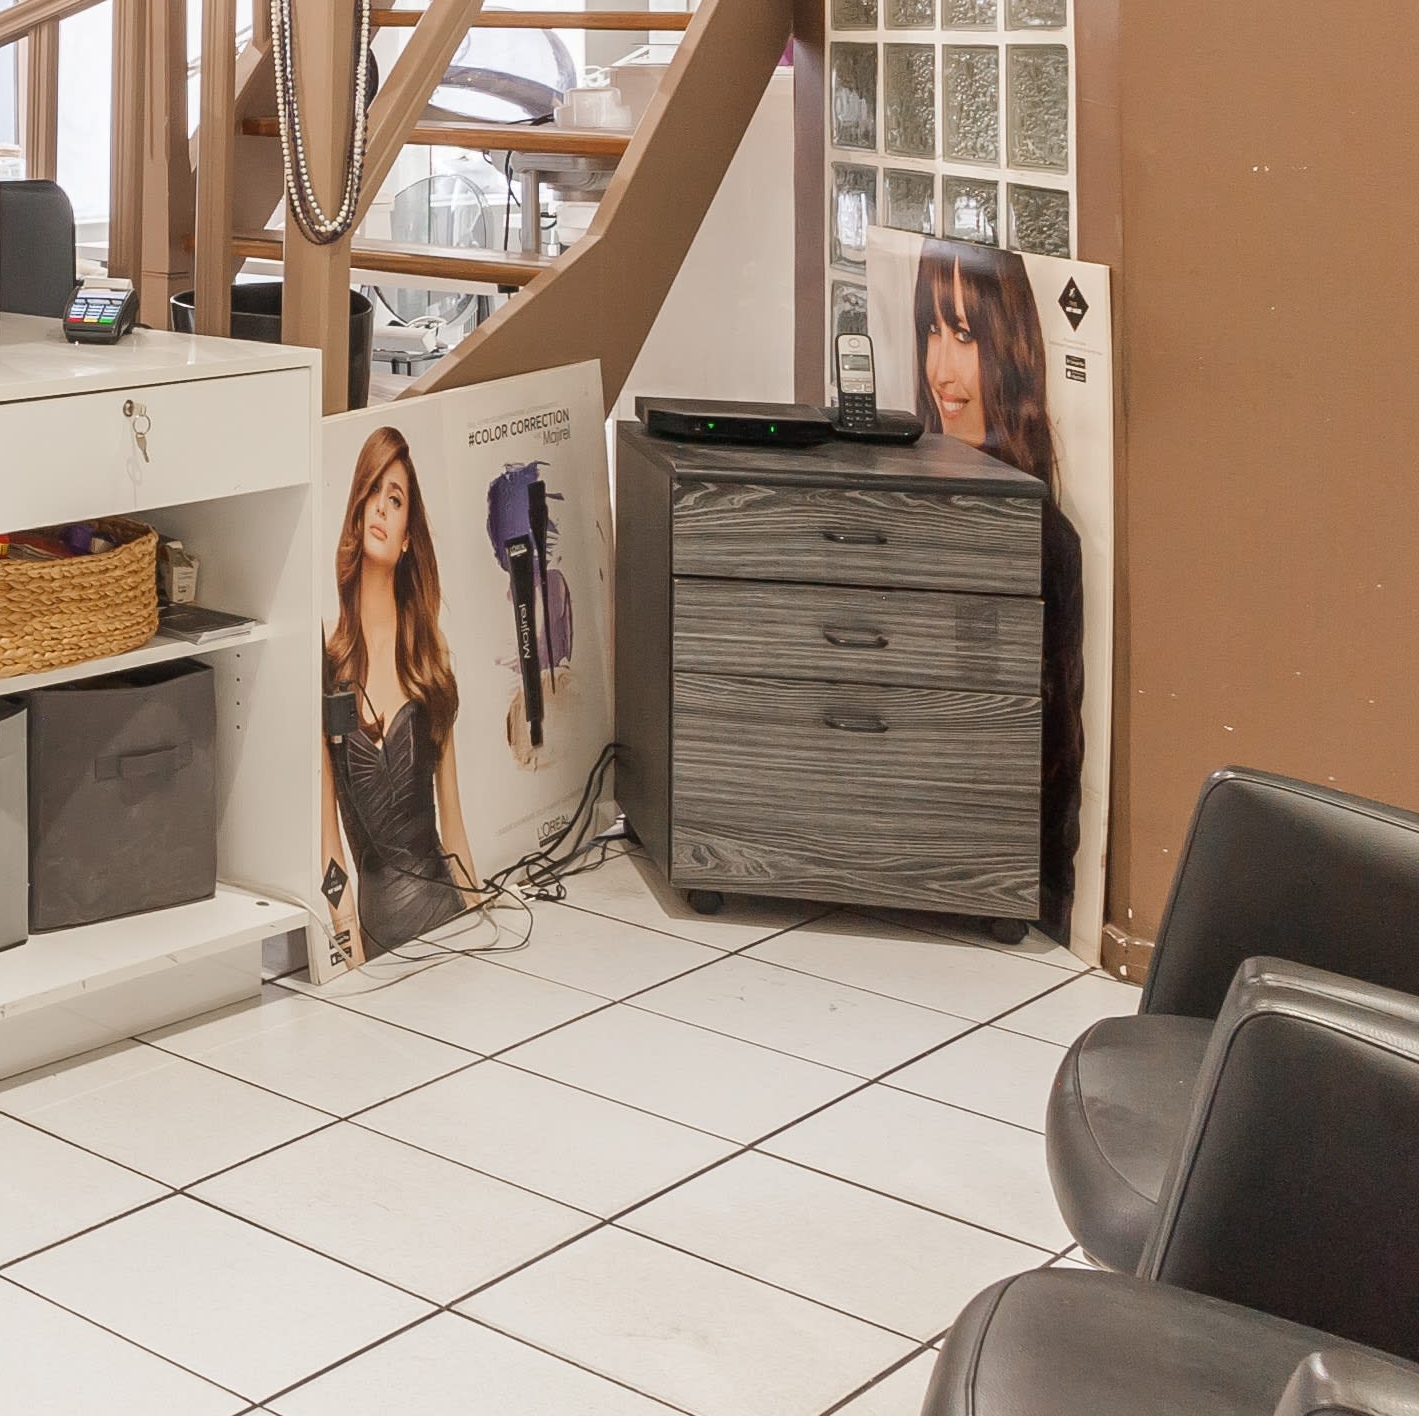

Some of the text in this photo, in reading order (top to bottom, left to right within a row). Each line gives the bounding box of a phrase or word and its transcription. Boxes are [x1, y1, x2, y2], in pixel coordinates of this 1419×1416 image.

[468, 424, 508, 447] #COLOR
[510, 408, 570, 436] CORRECTION
[543, 424, 571, 446] Majirel
[518, 603, 531, 659] Majirel
